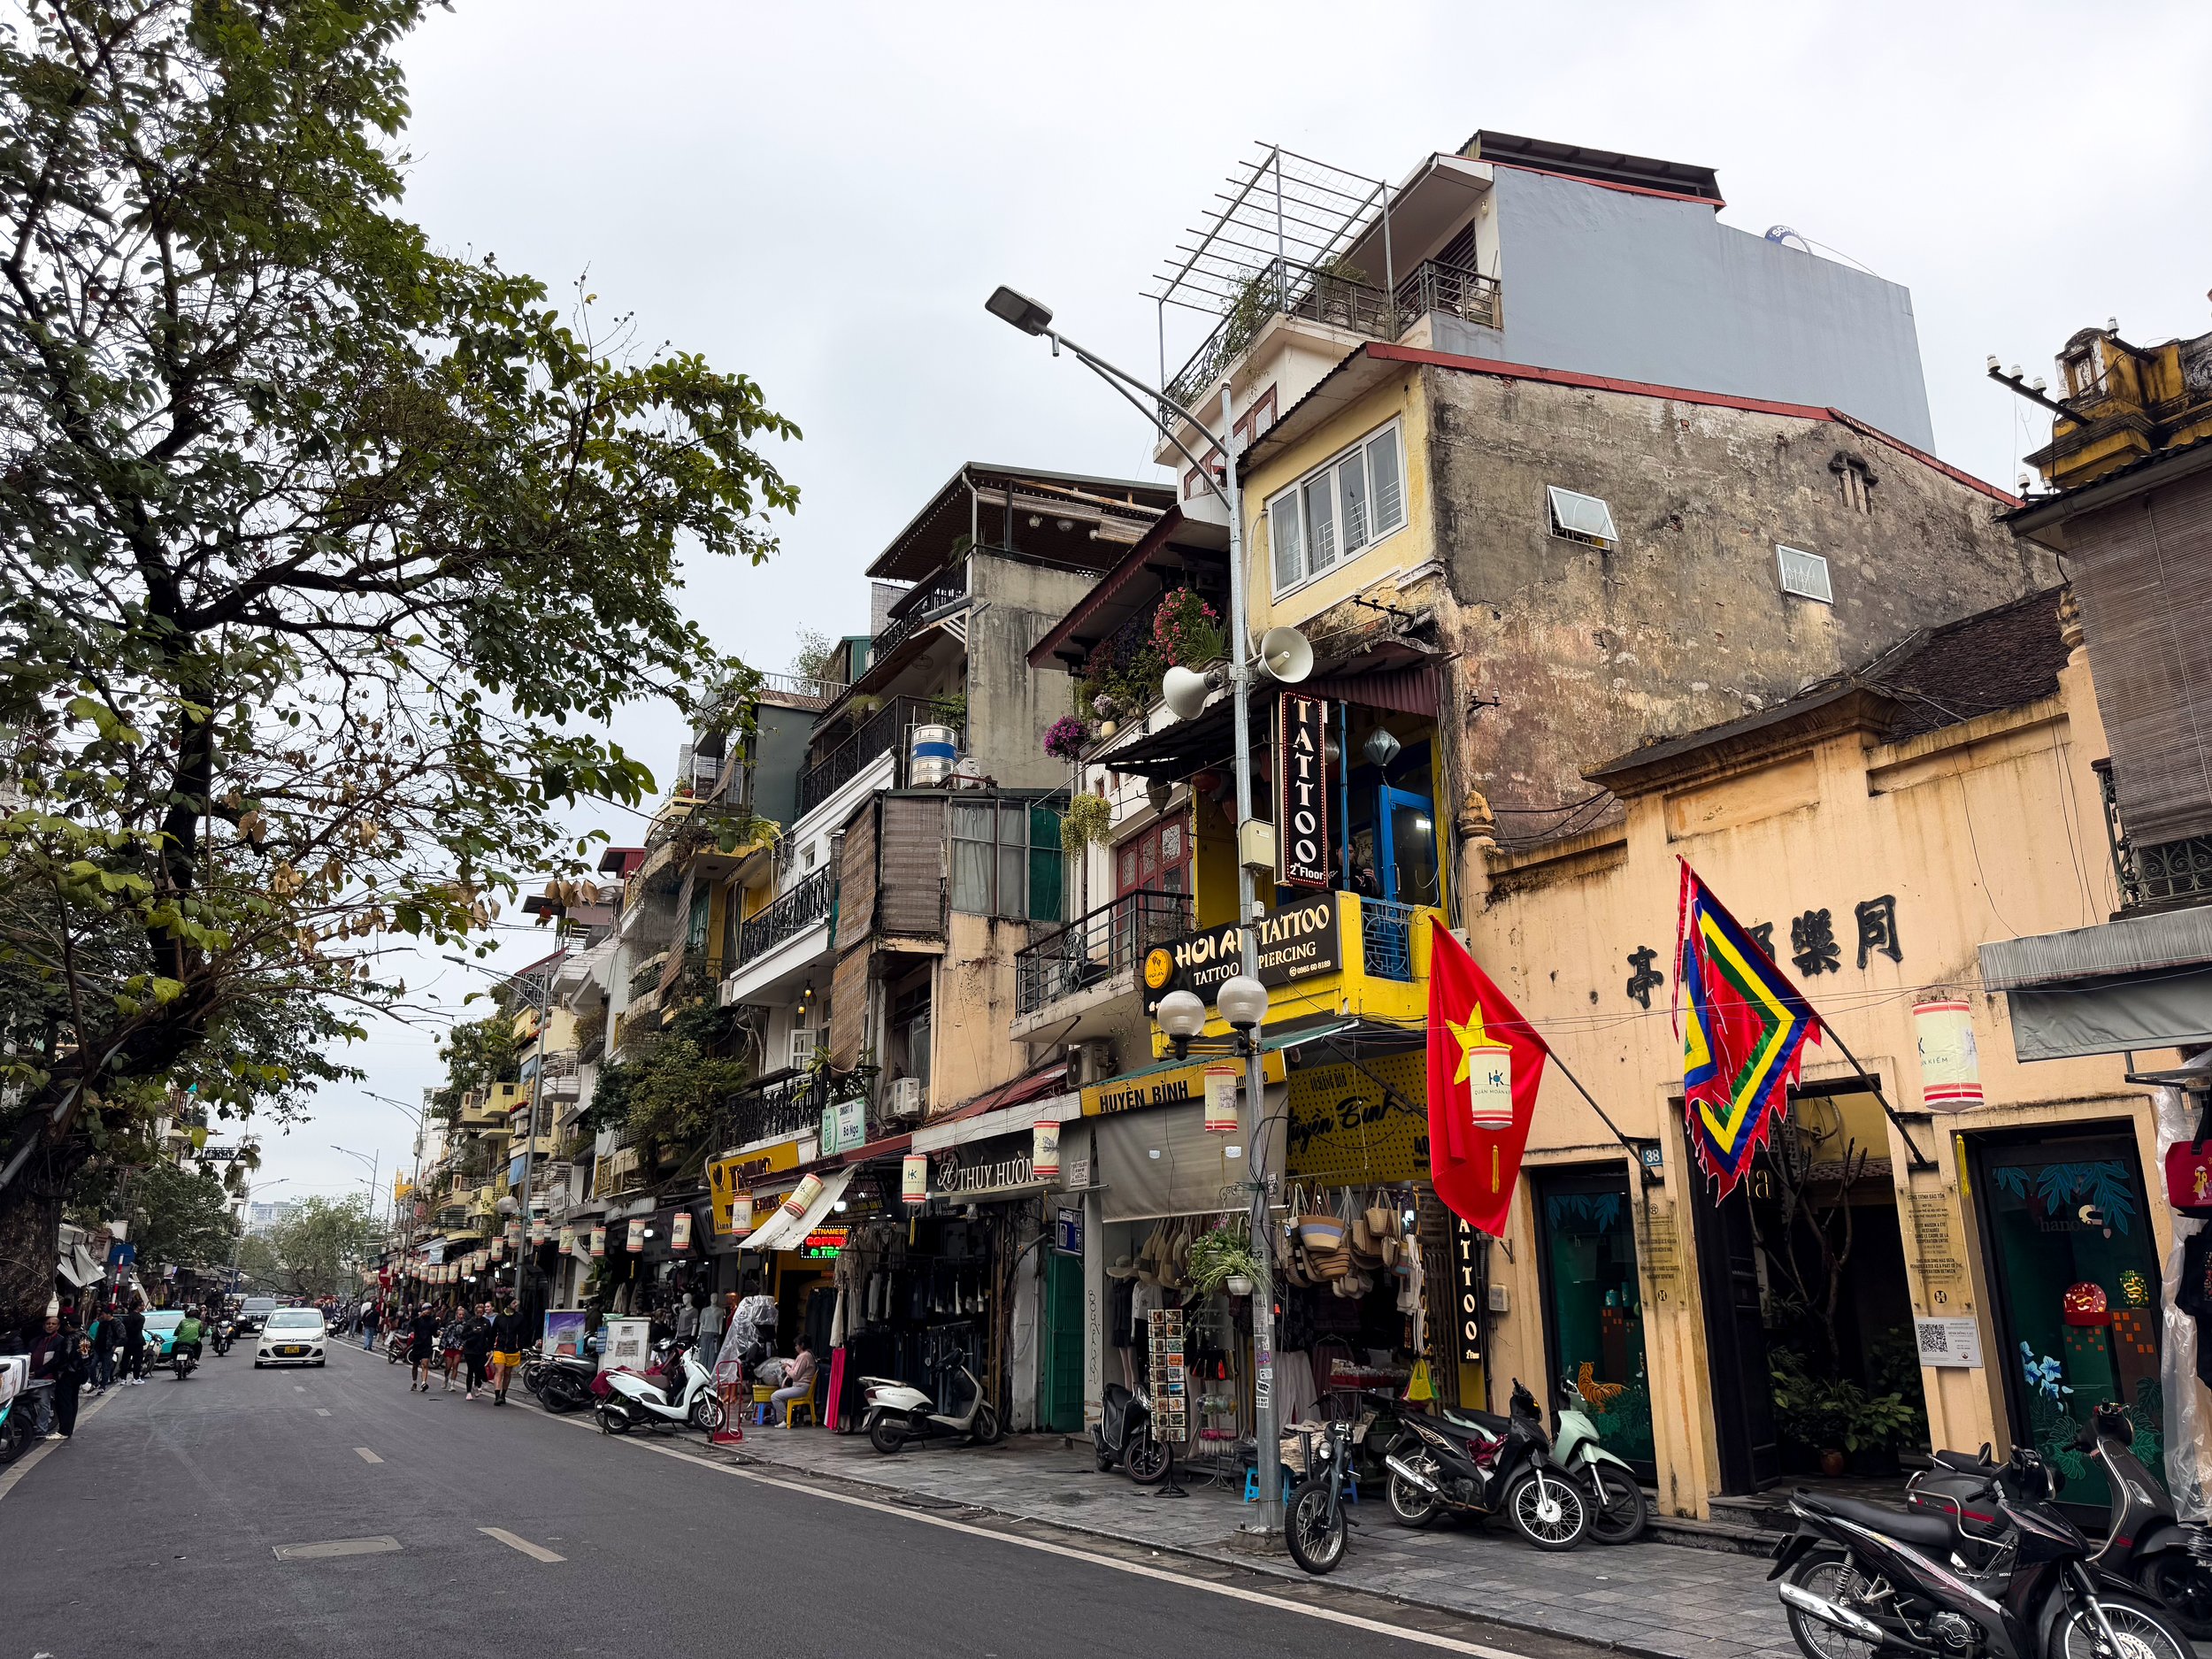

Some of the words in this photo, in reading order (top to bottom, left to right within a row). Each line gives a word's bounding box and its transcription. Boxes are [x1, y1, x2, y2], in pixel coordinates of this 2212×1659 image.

[1294, 697, 1316, 863] TATTOO
[1300, 866, 1324, 879] Floor
[1175, 934, 1216, 969] HOI
[1258, 903, 1330, 946] TATTOO
[1194, 962, 1239, 987] TATTOO
[1257, 941, 1317, 970] PIERCING
[1100, 1083, 1145, 1113] HUYỀN
[1152, 1077, 1189, 1103] BÌNH
[959, 1156, 993, 1191] THÚY
[996, 1151, 1044, 1187] HƯỜN
[1646, 1149, 1660, 1163] 38
[1459, 1217, 1478, 1340] ATTOO
